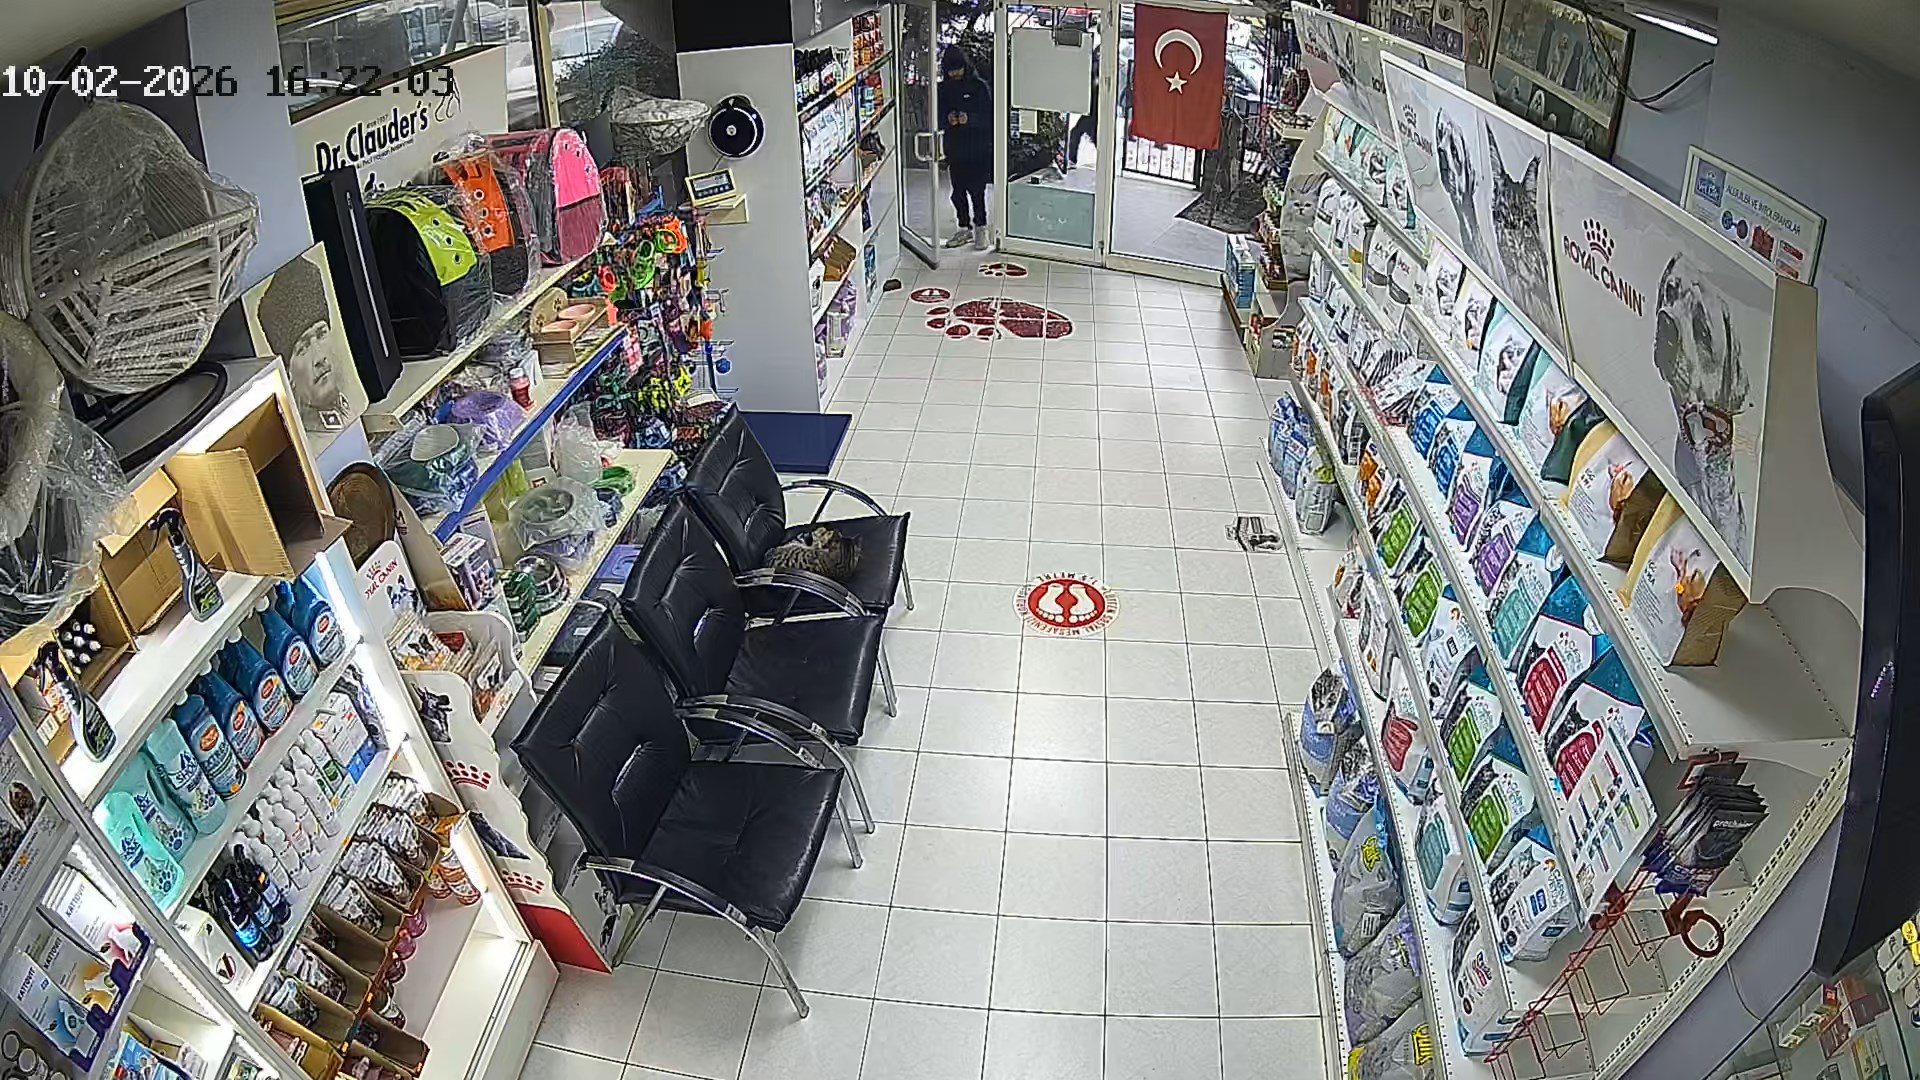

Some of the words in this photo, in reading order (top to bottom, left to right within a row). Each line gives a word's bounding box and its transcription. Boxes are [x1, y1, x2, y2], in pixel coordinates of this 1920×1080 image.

[316, 141, 347, 174] Dr.
[345, 100, 429, 162] Clauder's
[1563, 234, 1600, 281] ROYAL
[1600, 265, 1643, 317] CANIN
[64, 882, 86, 918] KATTOVIT
[43, 935, 63, 971] KATTOVIT
[16, 965, 37, 1002] KATTOVIT
